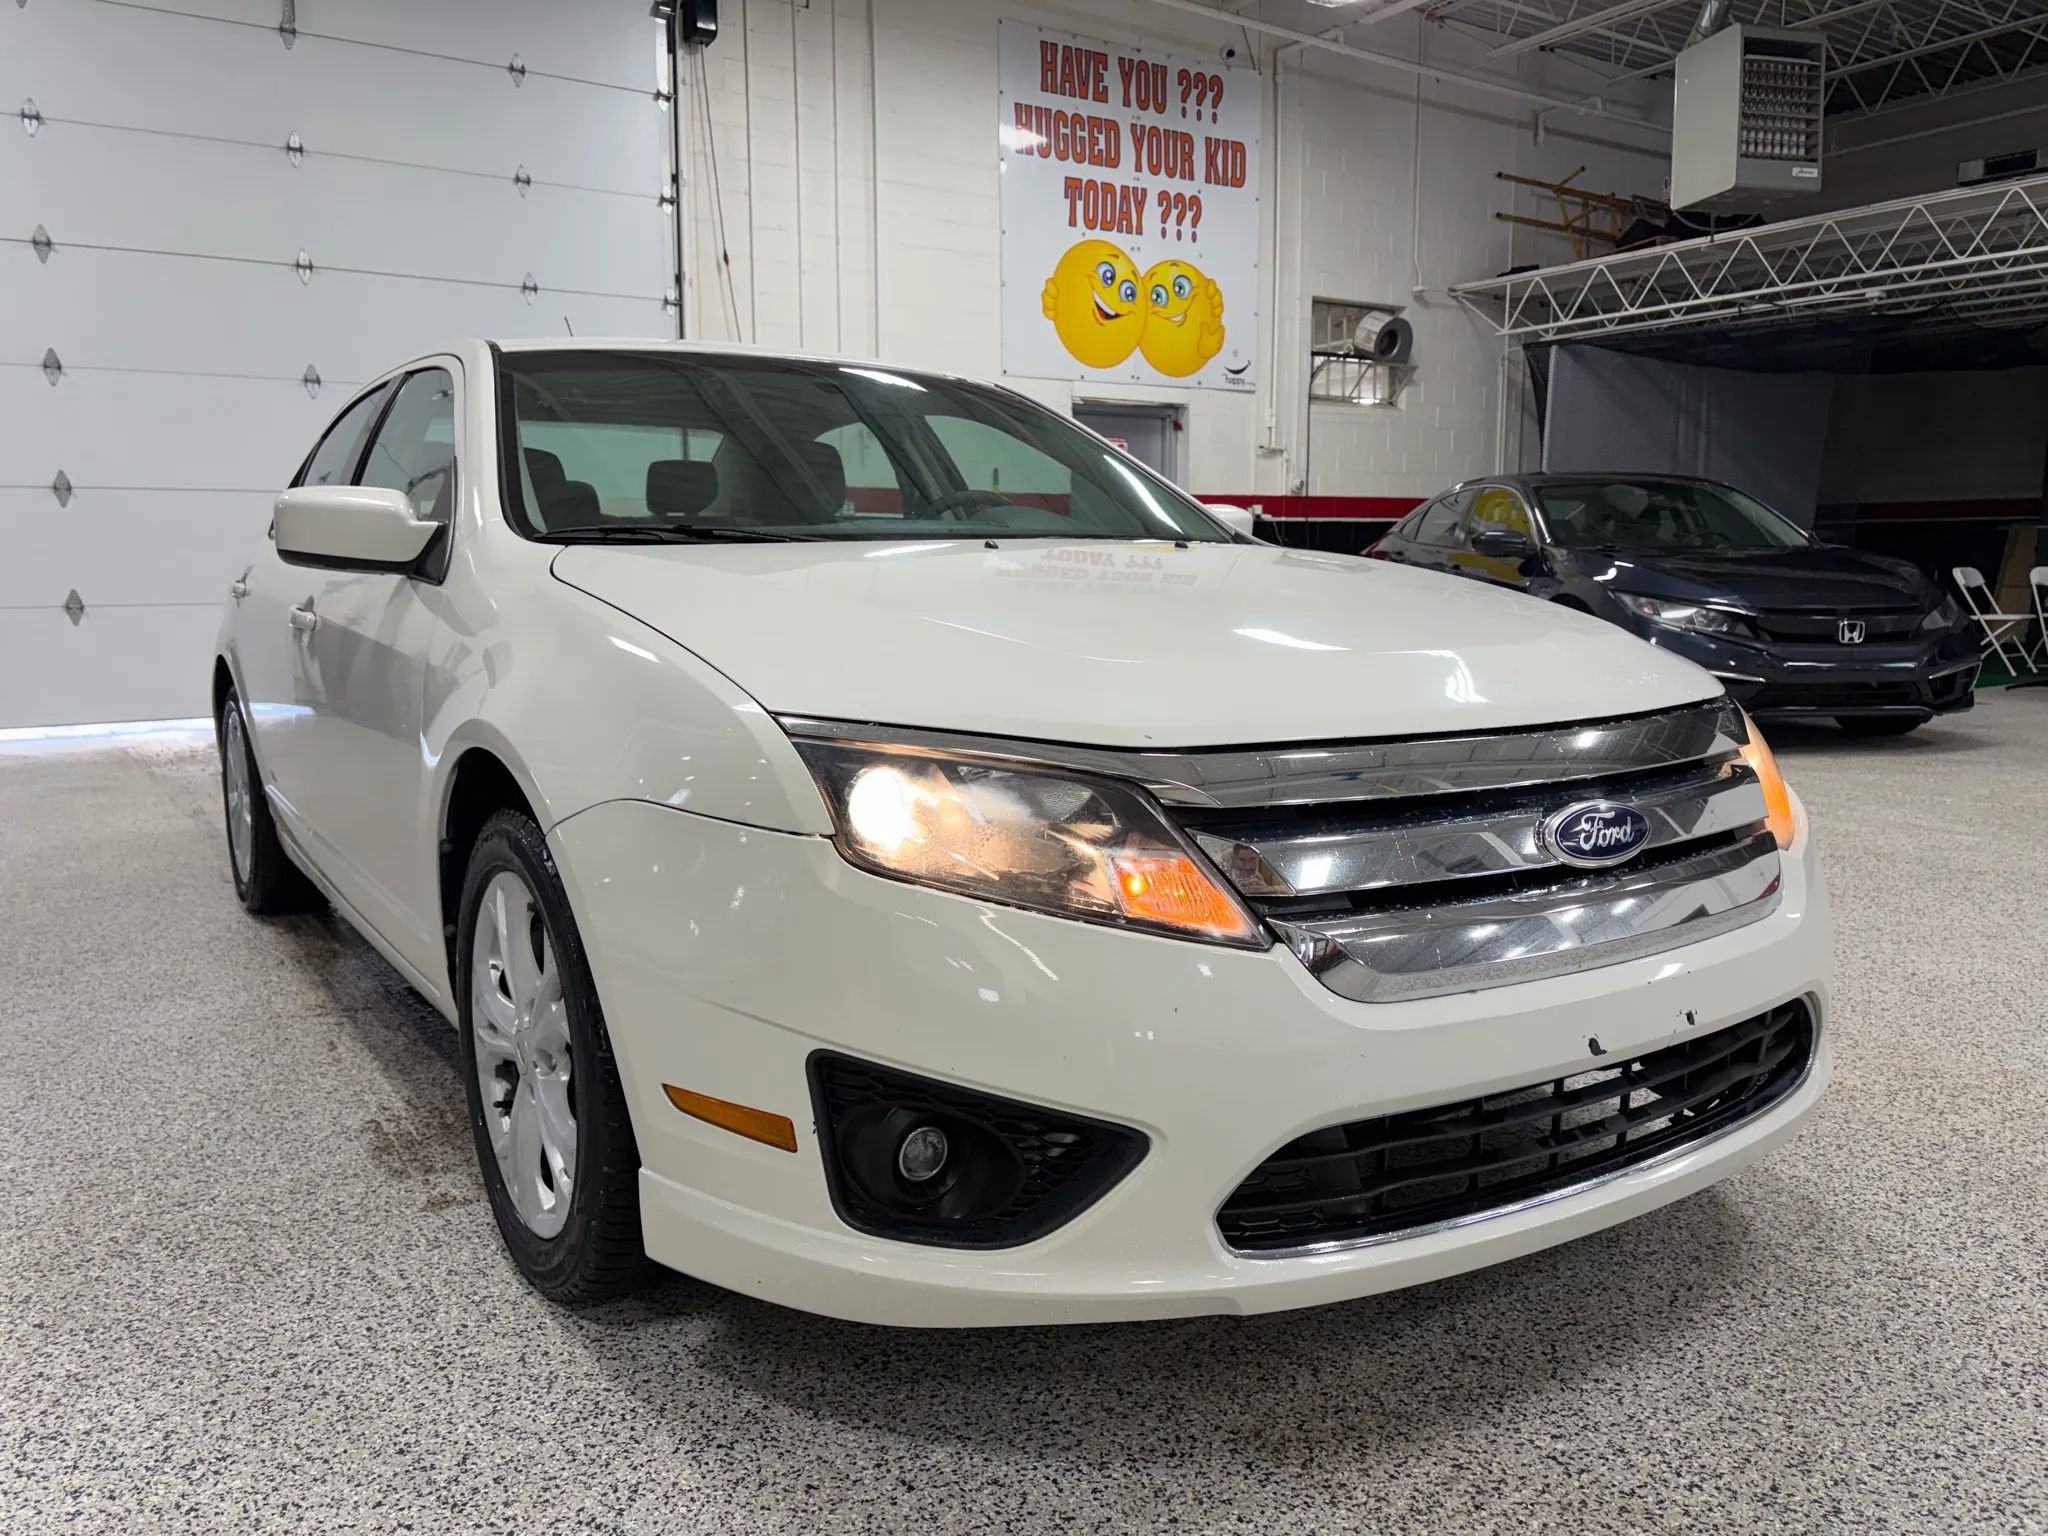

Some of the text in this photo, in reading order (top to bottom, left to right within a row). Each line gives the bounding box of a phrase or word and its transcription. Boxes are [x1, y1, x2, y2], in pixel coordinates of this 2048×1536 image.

[1040, 40, 1224, 124] HAVE YOU ???
[1014, 102, 1247, 189] HUGGED YOUR KID
[1064, 176, 1202, 243] TODAY ???
[1574, 811, 1635, 851] Ford
